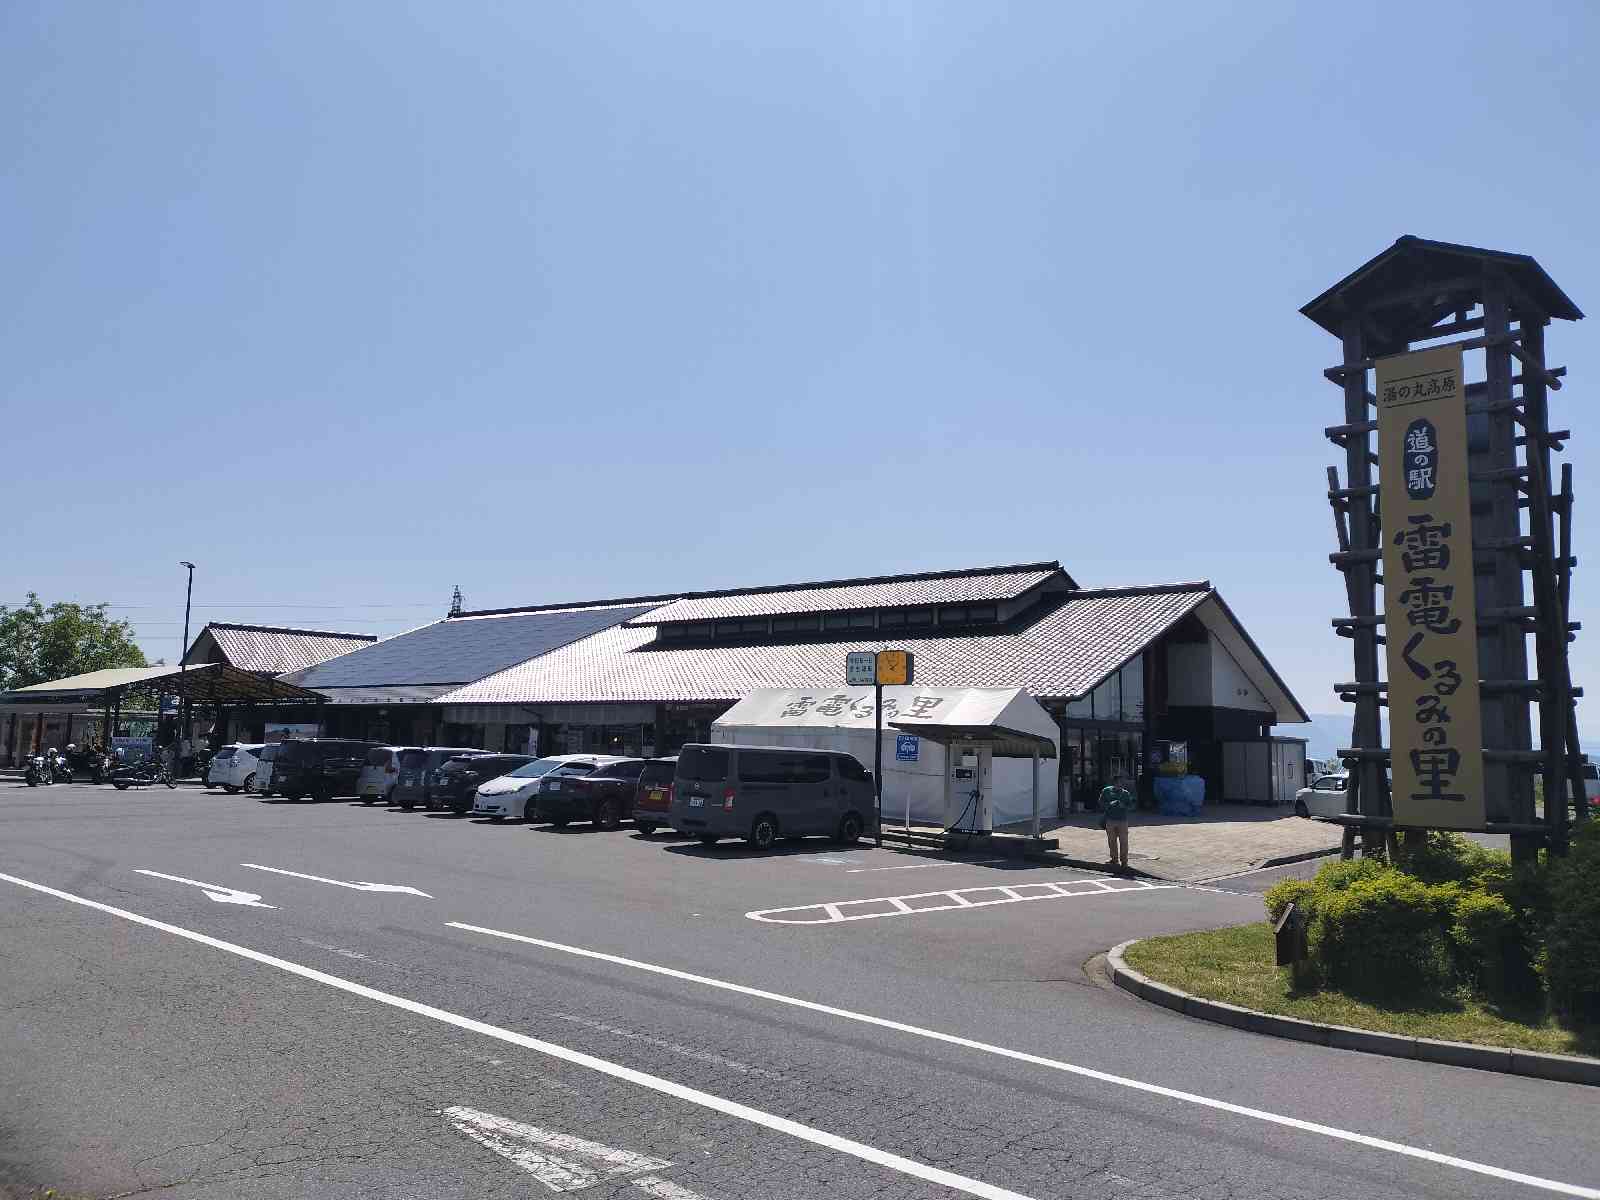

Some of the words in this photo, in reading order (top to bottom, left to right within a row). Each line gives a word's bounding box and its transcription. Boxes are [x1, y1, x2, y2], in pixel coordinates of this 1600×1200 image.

[1407, 426, 1435, 490] 道の駅
[1393, 514, 1466, 802] 雷電くるみの里
